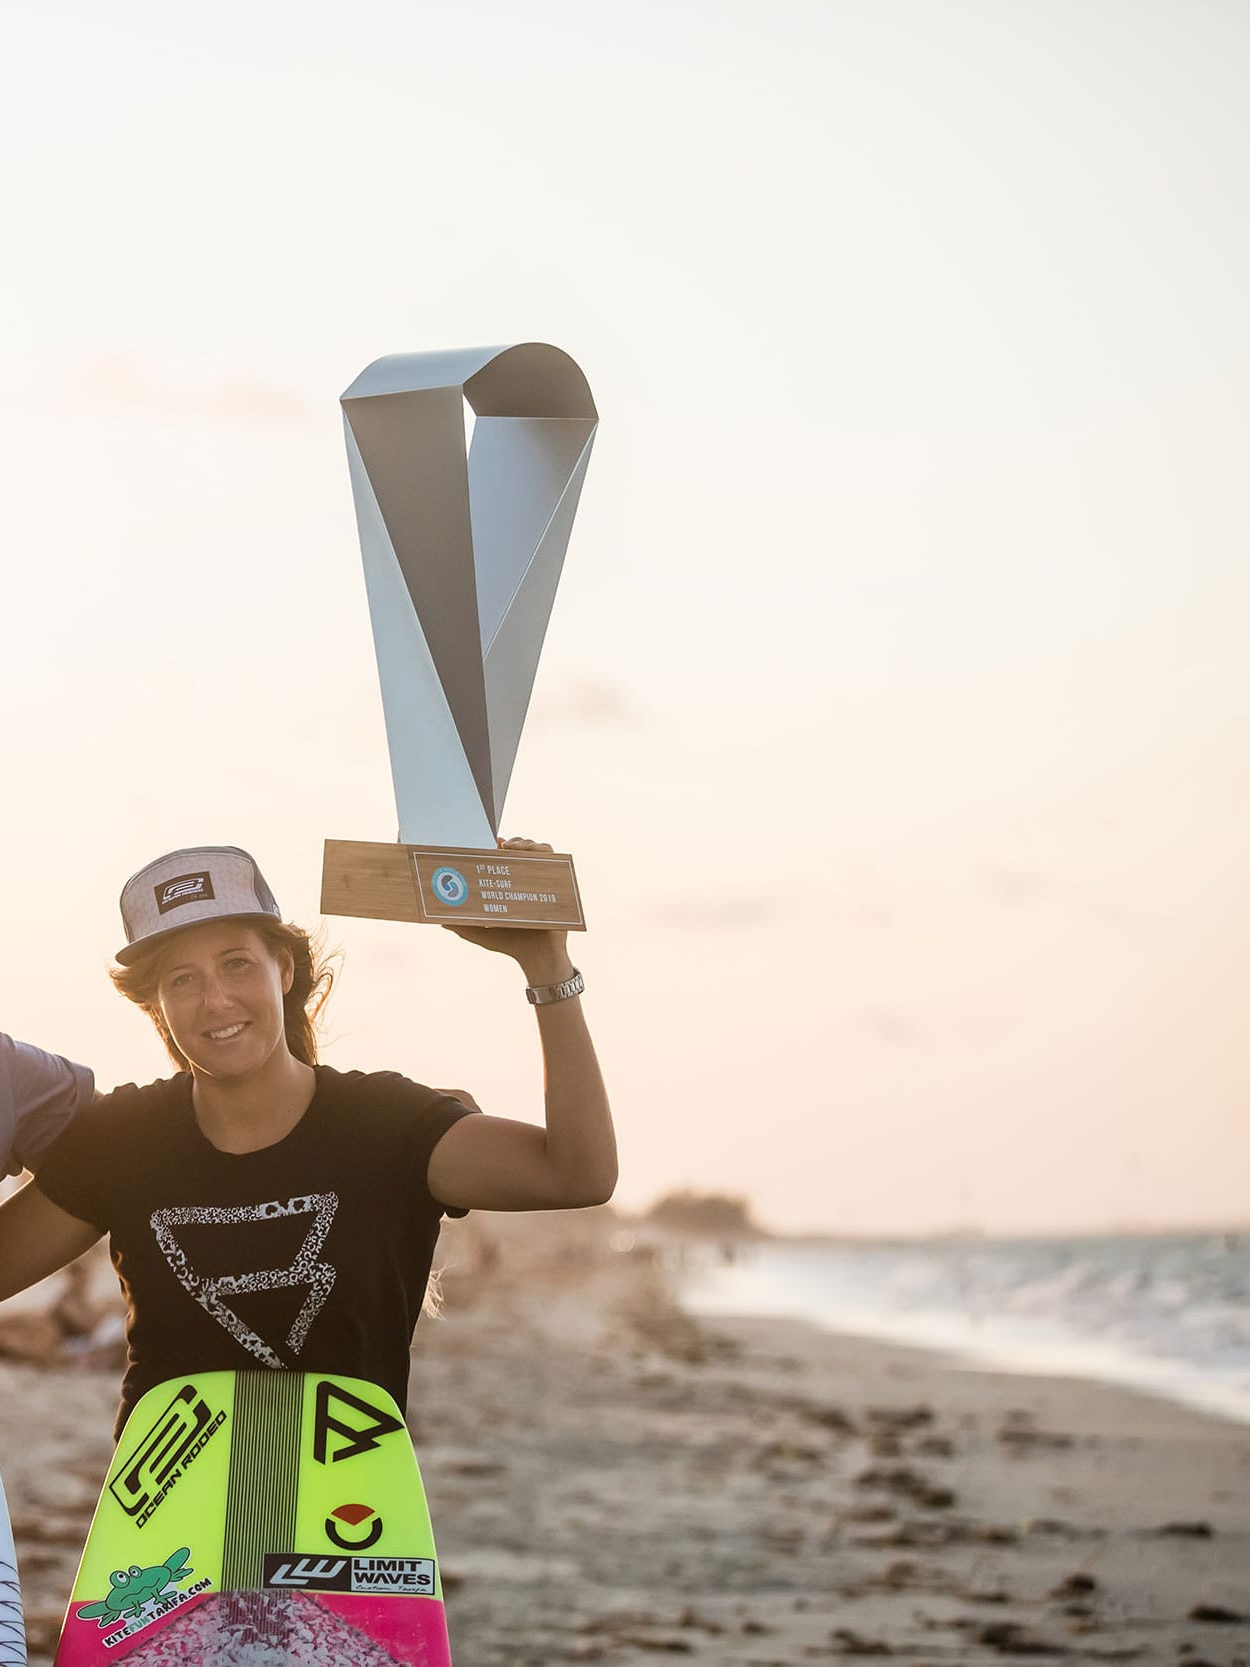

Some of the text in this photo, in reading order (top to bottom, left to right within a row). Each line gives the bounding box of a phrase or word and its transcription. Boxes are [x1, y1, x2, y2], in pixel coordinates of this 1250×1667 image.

[487, 865, 510, 876] PLACE
[478, 878, 512, 888] KITE-SURF
[480, 890, 504, 900] WORLD
[504, 892, 538, 902] CHAMPION
[483, 903, 508, 912] WOMEN
[135, 1408, 228, 1529] OCEAN RODEO
[354, 1559, 422, 1572] LIMIT
[354, 1572, 431, 1586] WAVES
[104, 1577, 212, 1646] KITEFUNTARIFA.COM
